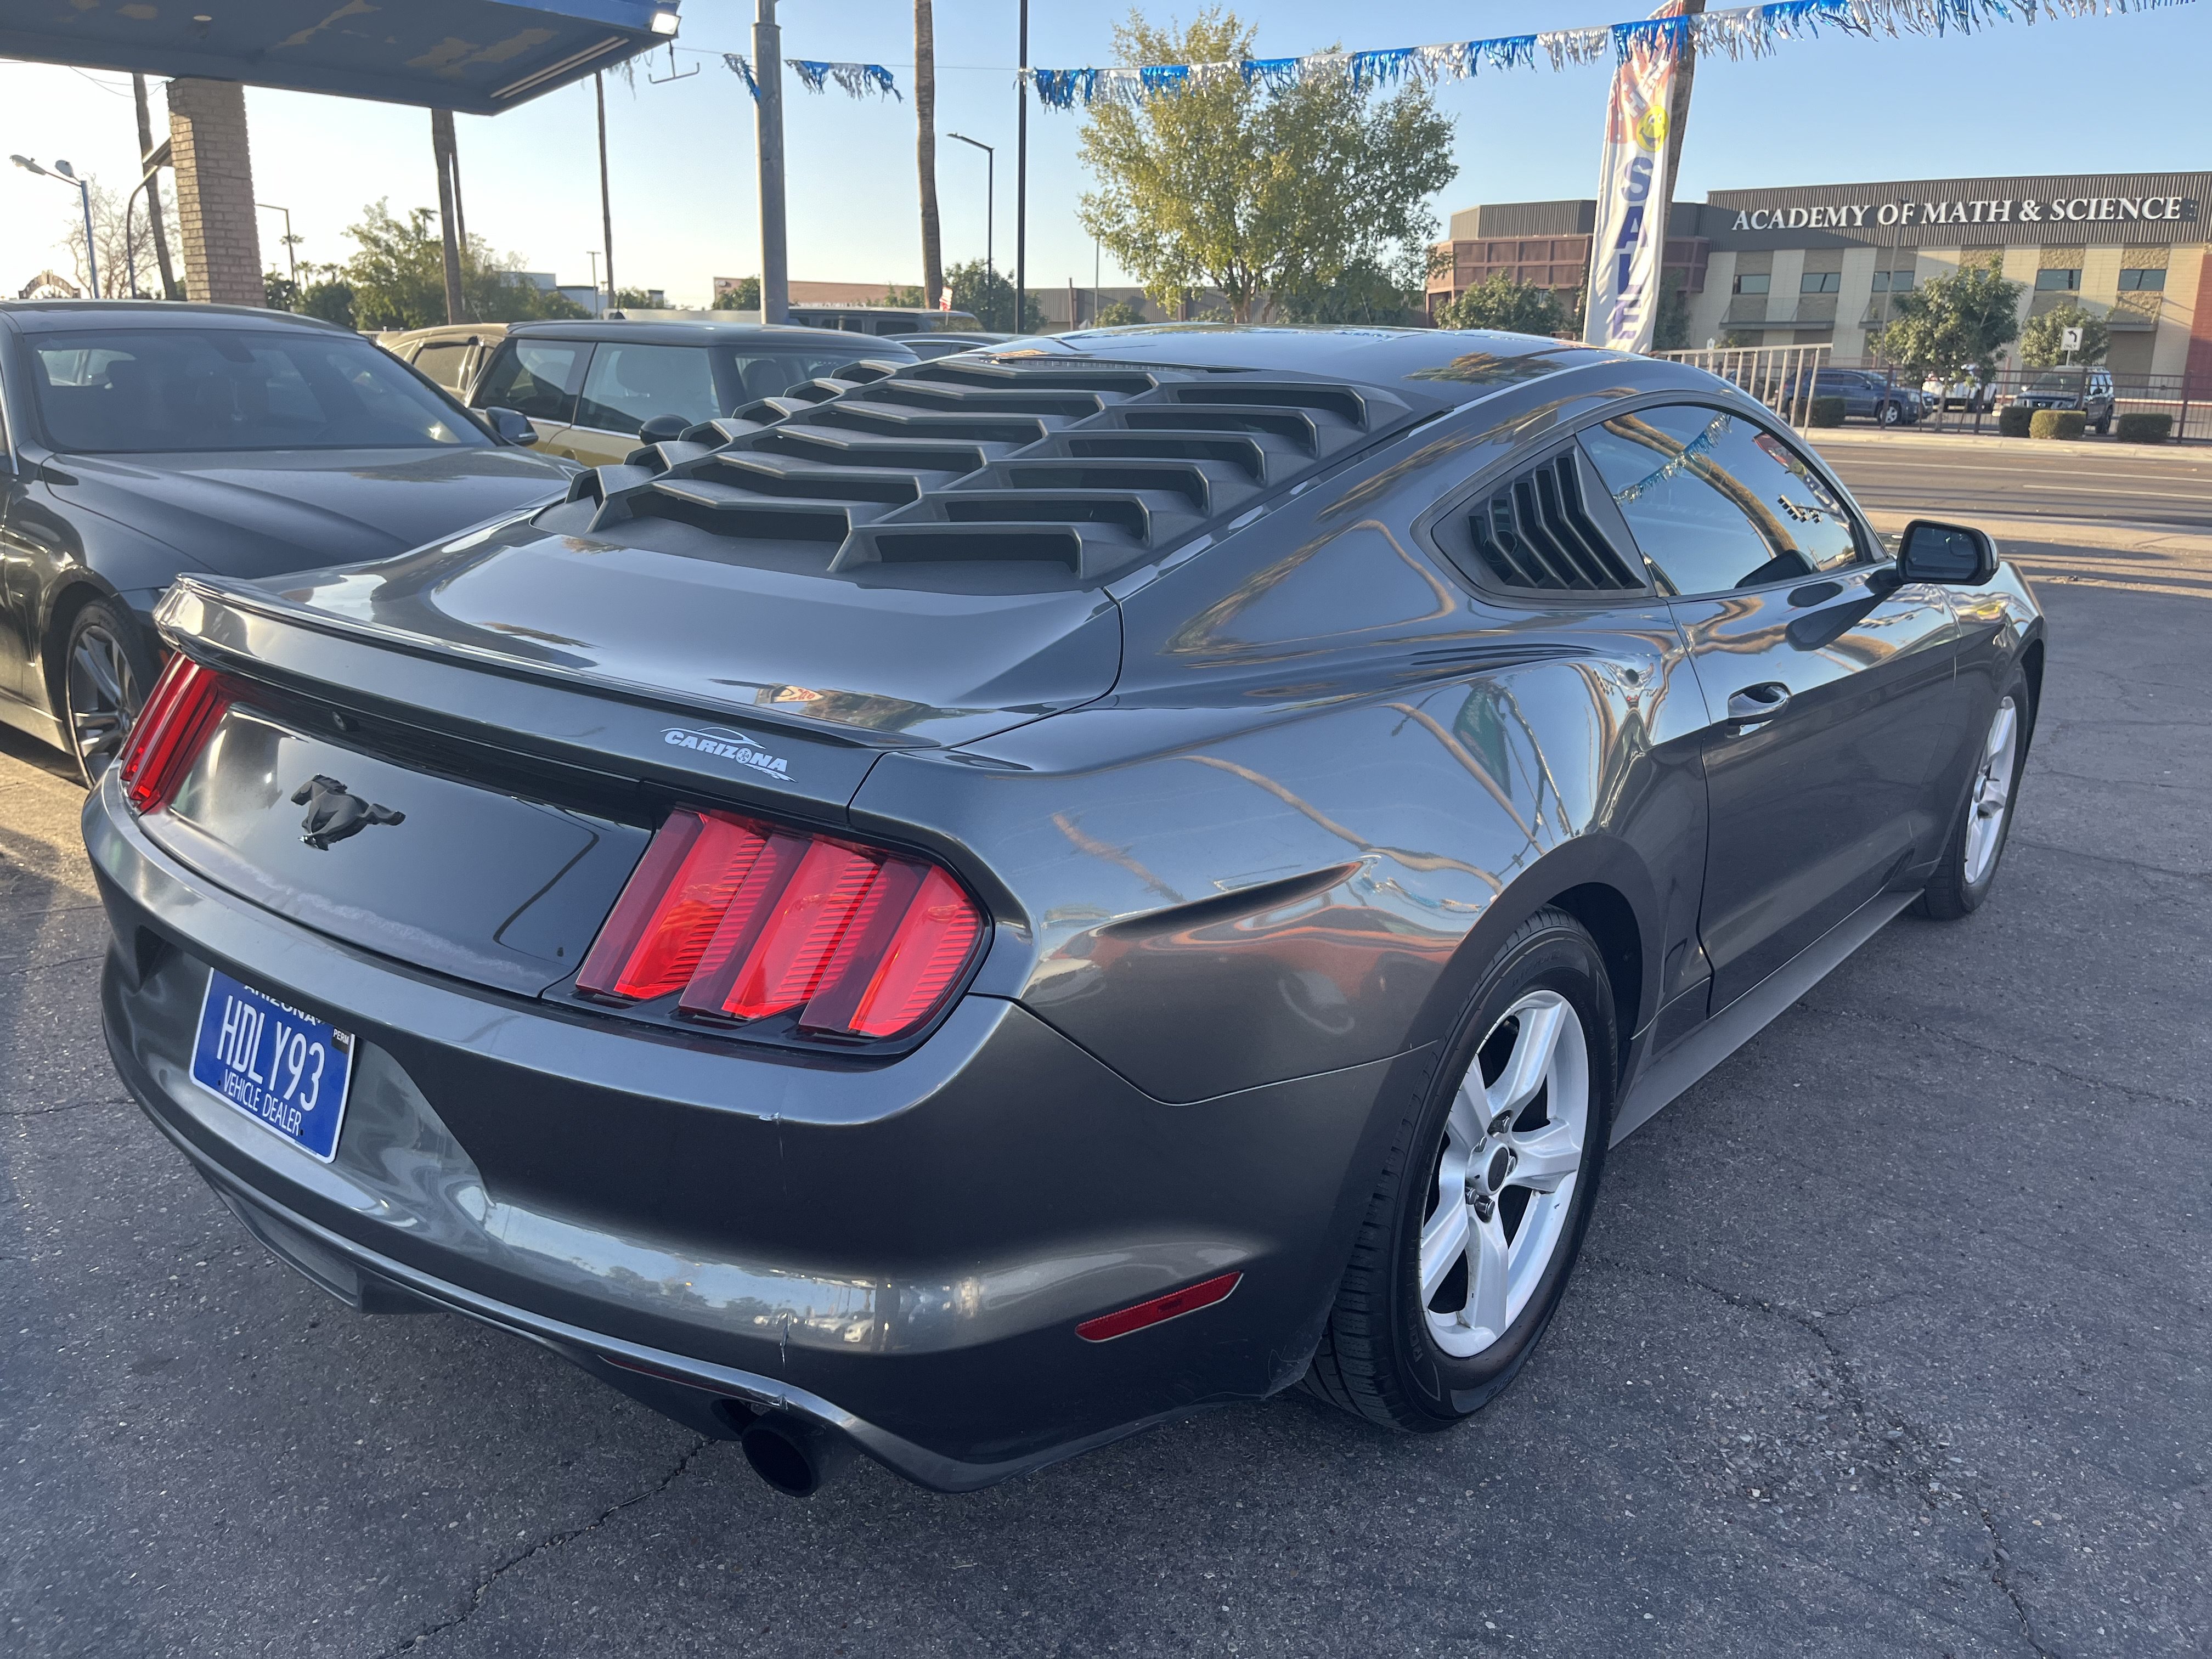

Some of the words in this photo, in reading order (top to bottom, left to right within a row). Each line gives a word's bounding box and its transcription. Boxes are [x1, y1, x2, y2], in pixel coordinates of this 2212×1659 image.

[1731, 205, 1871, 231] ACADEMY
[1877, 202, 1915, 226] OF
[1920, 199, 2012, 224] MATH
[2018, 199, 2044, 222] &
[2049, 196, 2182, 221] SCIENCE
[1612, 156, 1654, 340] SALE
[664, 730, 788, 772] CARIZONA
[333, 1028, 349, 1045] PERM
[223, 1069, 262, 1112] VEHICLE
[262, 1093, 302, 1136] DEALER
